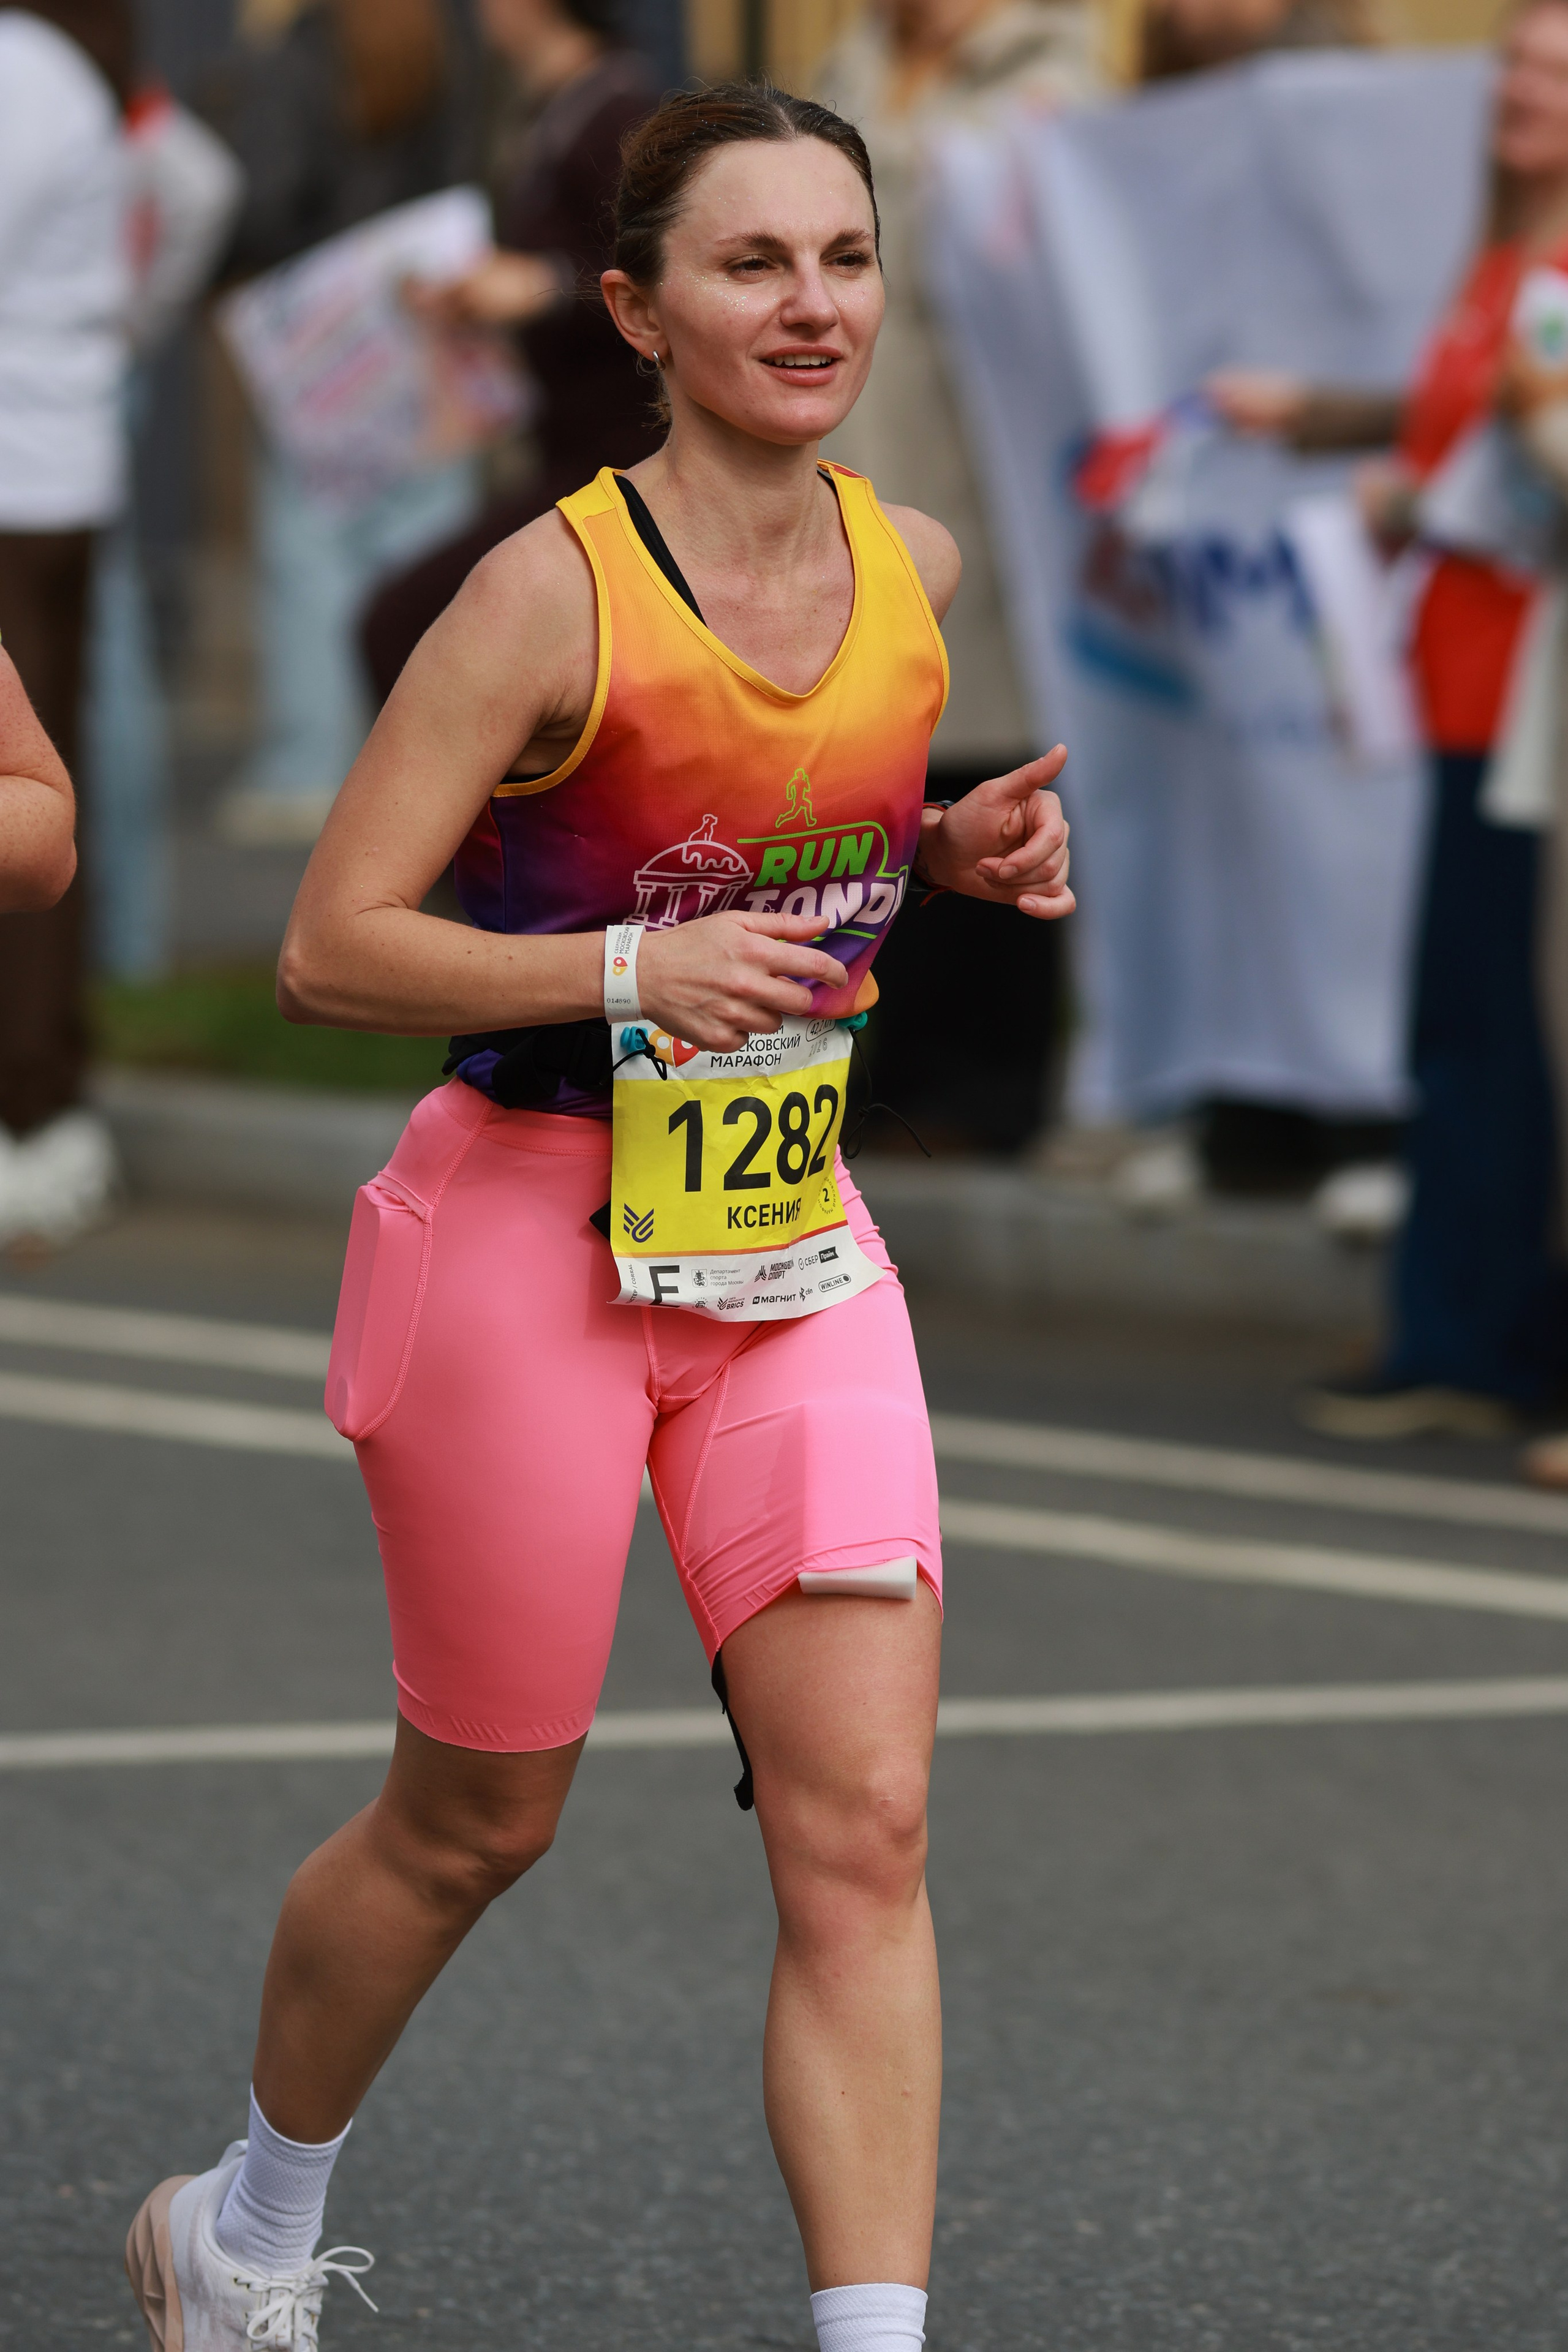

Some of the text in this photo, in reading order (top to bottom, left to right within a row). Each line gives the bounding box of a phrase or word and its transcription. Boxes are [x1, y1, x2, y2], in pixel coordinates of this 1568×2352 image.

[754, 831, 874, 887] RUN
[625, 932, 634, 954] МАРАФОН
[710, 1053, 782, 1068] МАРАФОН
[668, 1084, 839, 1192] 1282
[823, 1188, 830, 1202] 2
[727, 1197, 801, 1229] КСЕНИЯ
[805, 1254, 818, 1266] СБЕР
[628, 1264, 636, 1284] CORRAL
[768, 1270, 785, 1280] СПОРТ
[821, 1277, 843, 1290] WINLINE
[726, 1301, 744, 1310] BRICS
